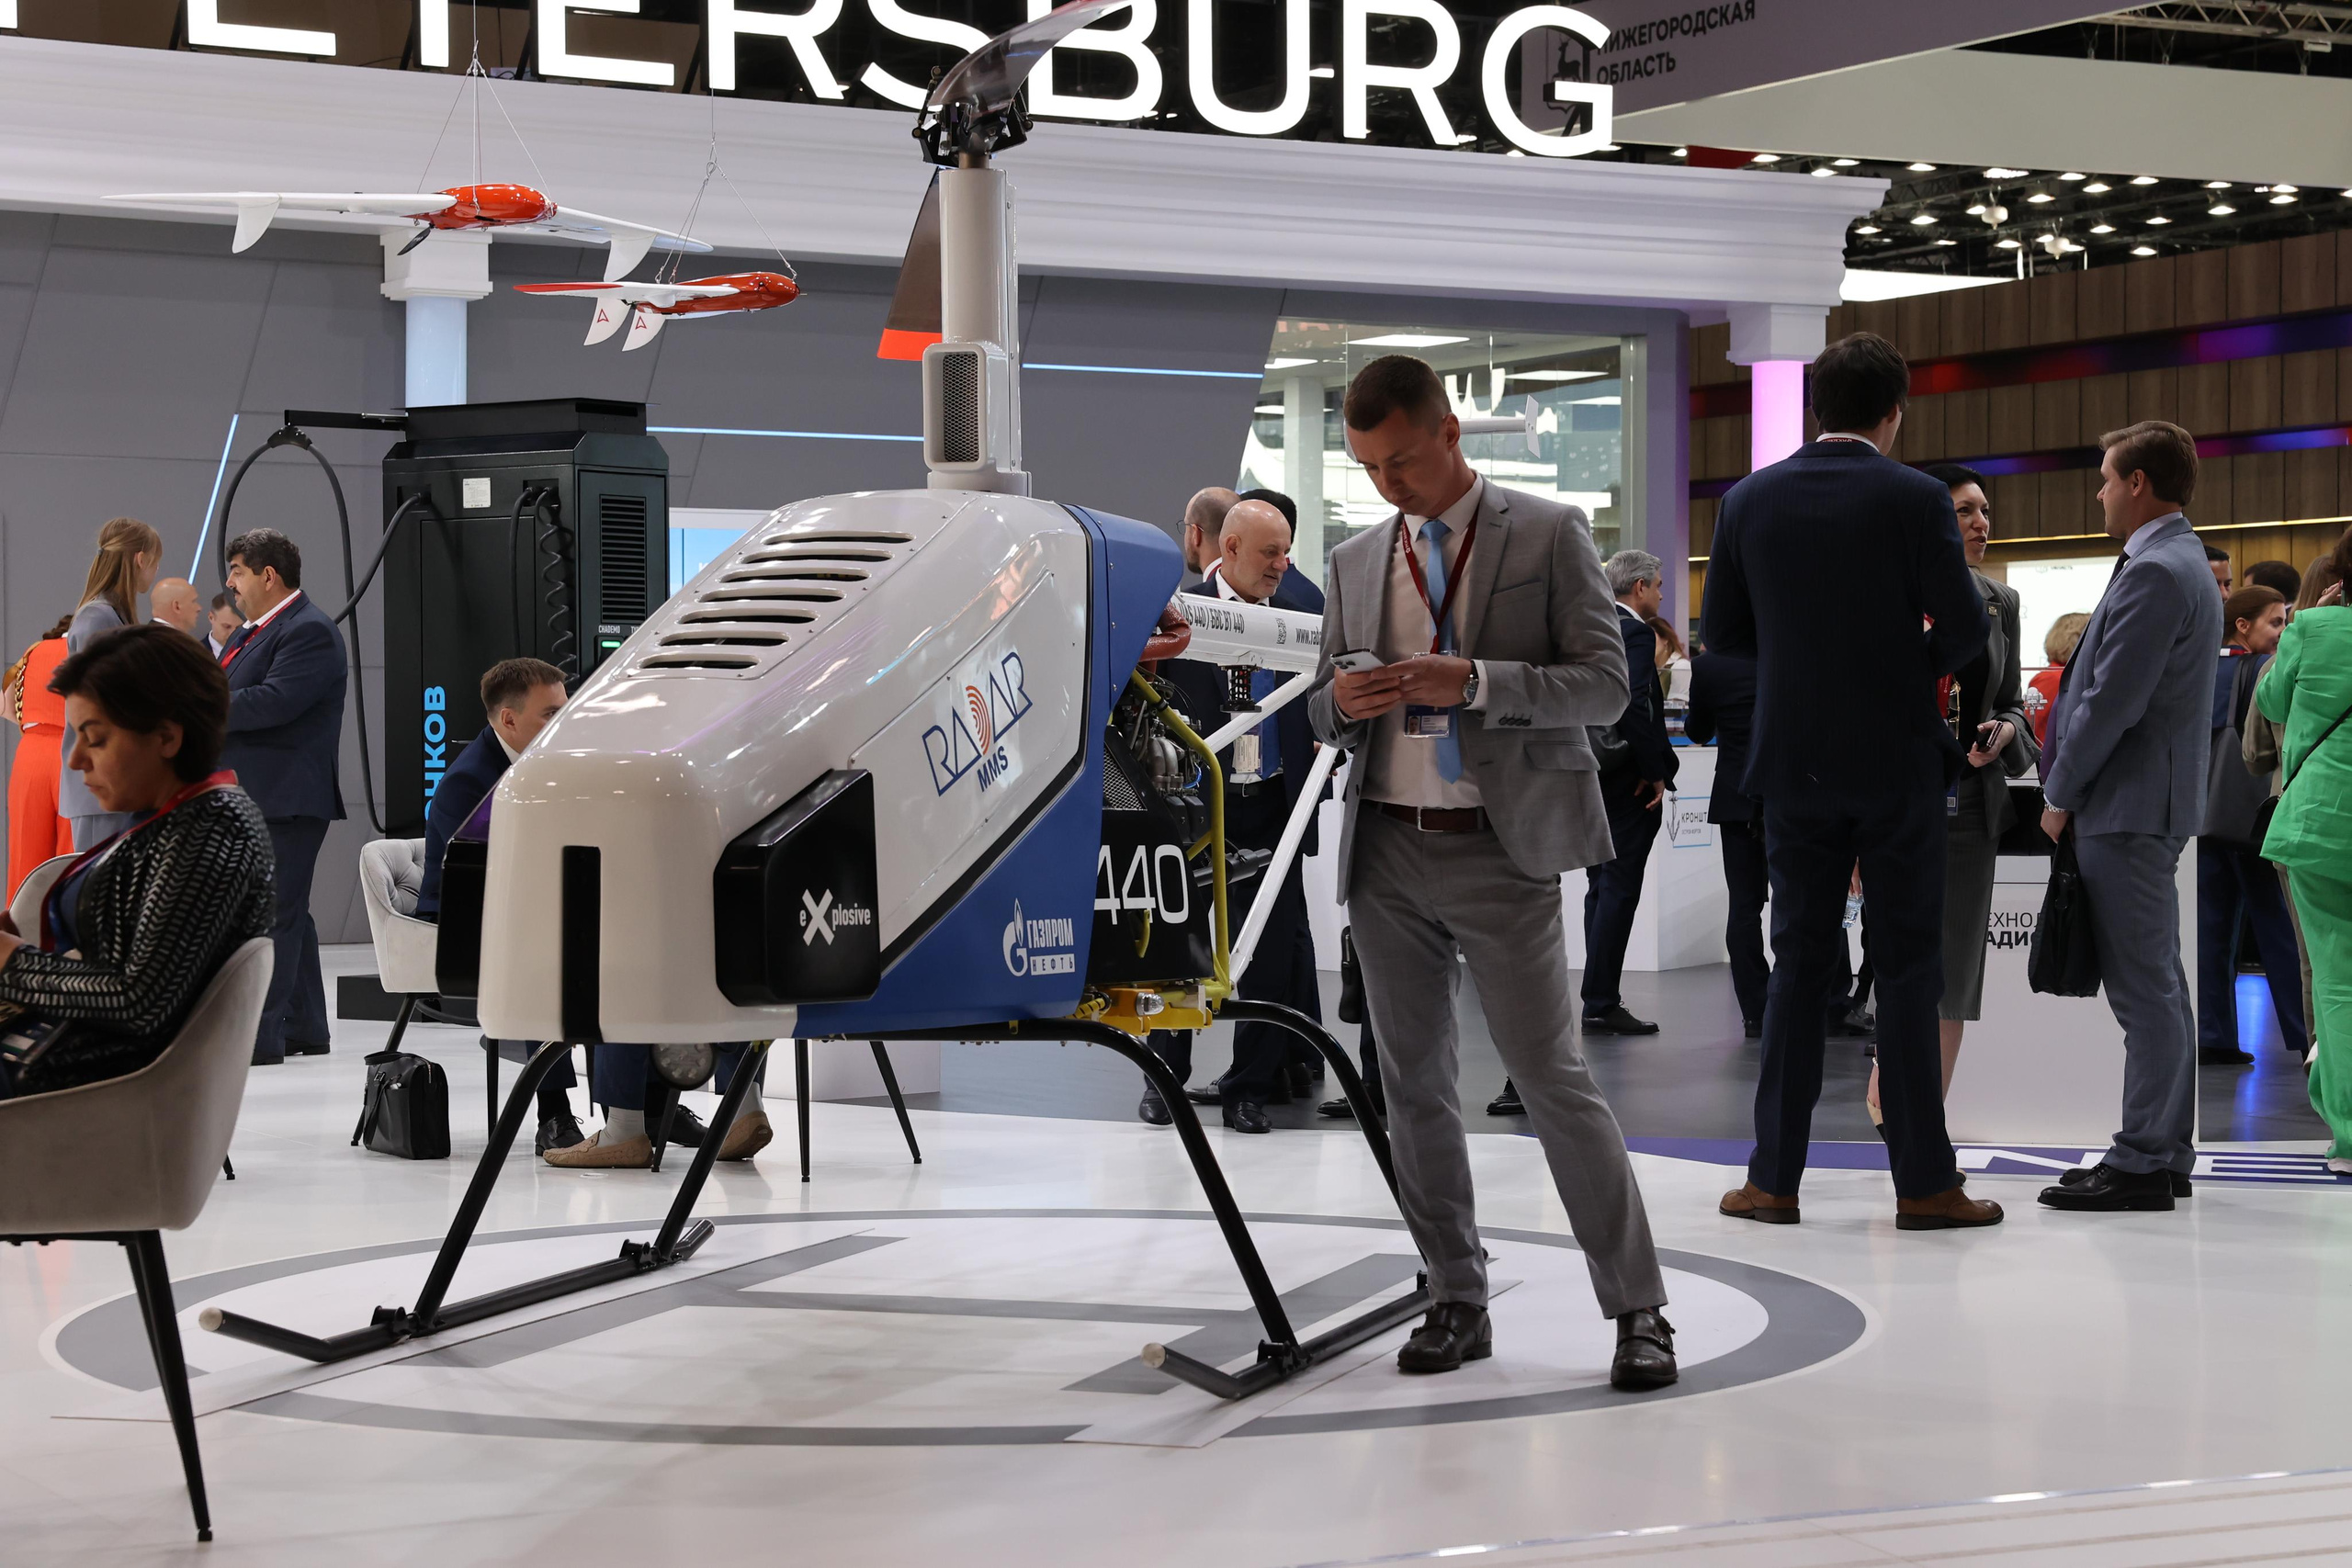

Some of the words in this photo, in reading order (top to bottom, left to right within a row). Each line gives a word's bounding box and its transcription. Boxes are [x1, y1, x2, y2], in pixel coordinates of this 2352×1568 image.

[1597, 51, 1677, 85] ОБЛАСТЬ
[598, 625, 621, 634] CHADEMO
[1232, 612, 1245, 635] 440
[922, 651, 1034, 797] RADAR
[424, 685, 446, 822] ЧКОВ
[977, 745, 1009, 793] MMS
[1093, 843, 1189, 925] 440
[799, 888, 871, 946] eXplosive
[1026, 918, 1074, 949] ГАЗПРОМ
[1986, 931, 2034, 950] АДИ
[1032, 956, 1074, 973] НЕФТЬ
